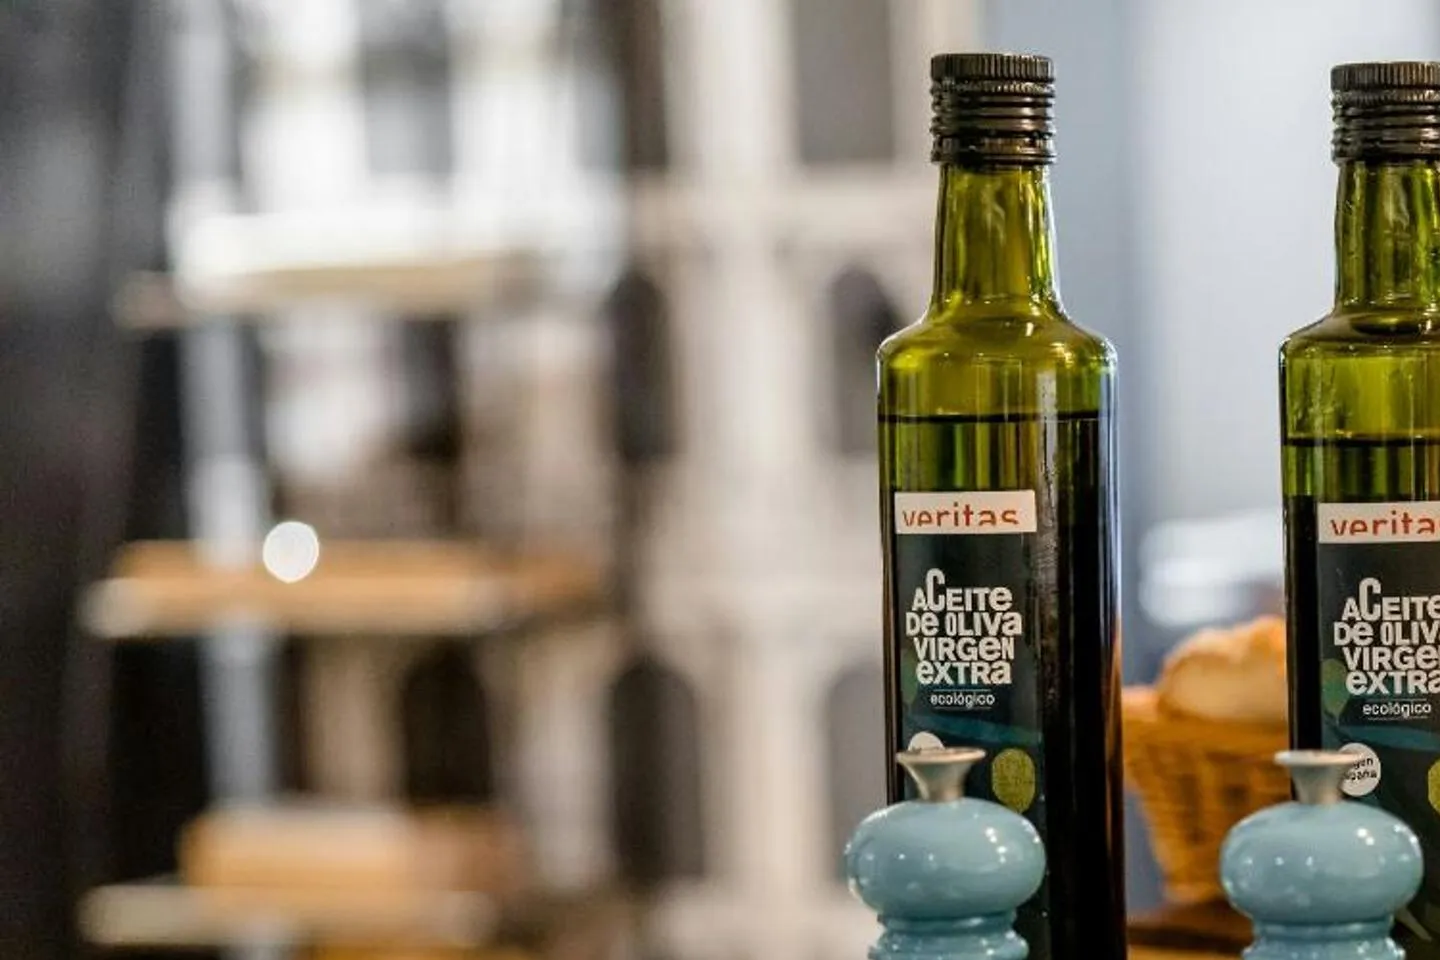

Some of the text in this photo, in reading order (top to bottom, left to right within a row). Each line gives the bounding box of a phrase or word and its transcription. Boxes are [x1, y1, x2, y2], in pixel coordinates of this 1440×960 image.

[903, 502, 1019, 527] veritas
[930, 691, 995, 708] ecológico
[1362, 702, 1432, 718] ecológico
